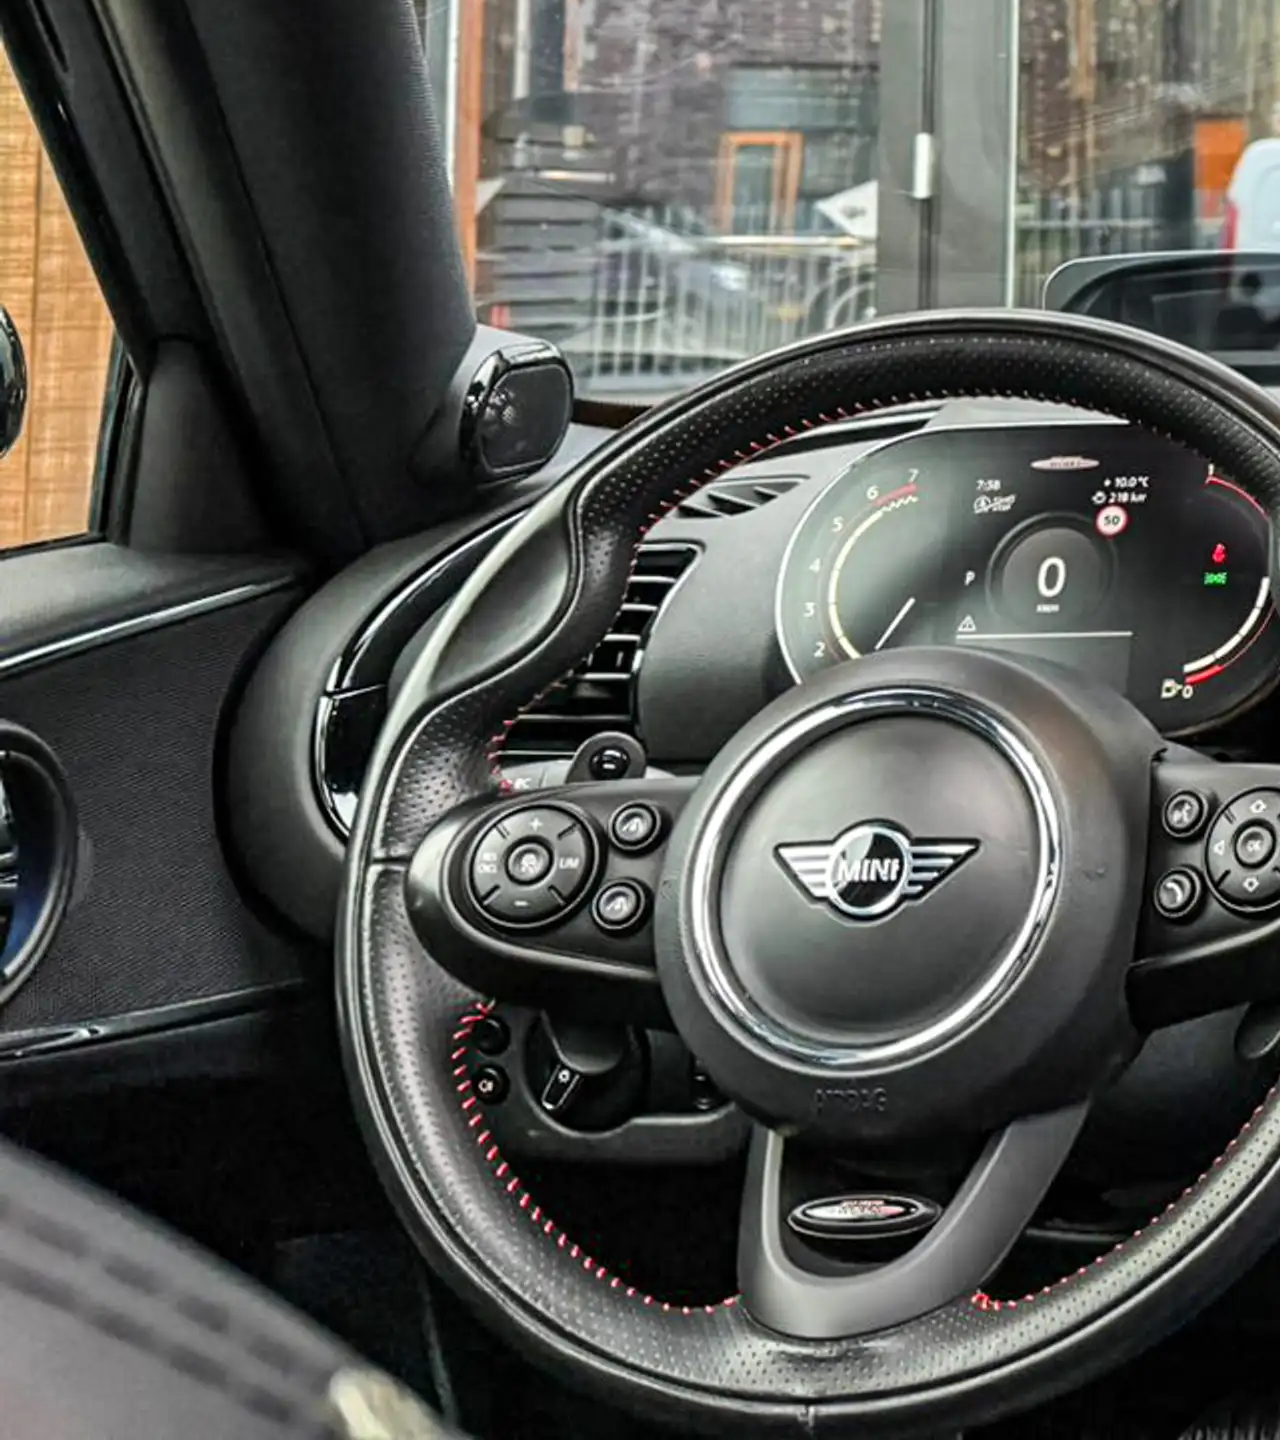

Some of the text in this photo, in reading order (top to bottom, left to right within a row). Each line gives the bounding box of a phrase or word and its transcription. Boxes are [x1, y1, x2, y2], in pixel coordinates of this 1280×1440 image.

[908, 468, 919, 483] 7
[866, 484, 879, 500] 6
[831, 516, 844, 532] 5
[1103, 515, 1120, 527] 50
[1037, 556, 1066, 598] 0
[803, 602, 815, 618] 3
[814, 642, 826, 658] 2
[836, 857, 901, 883] MINI
